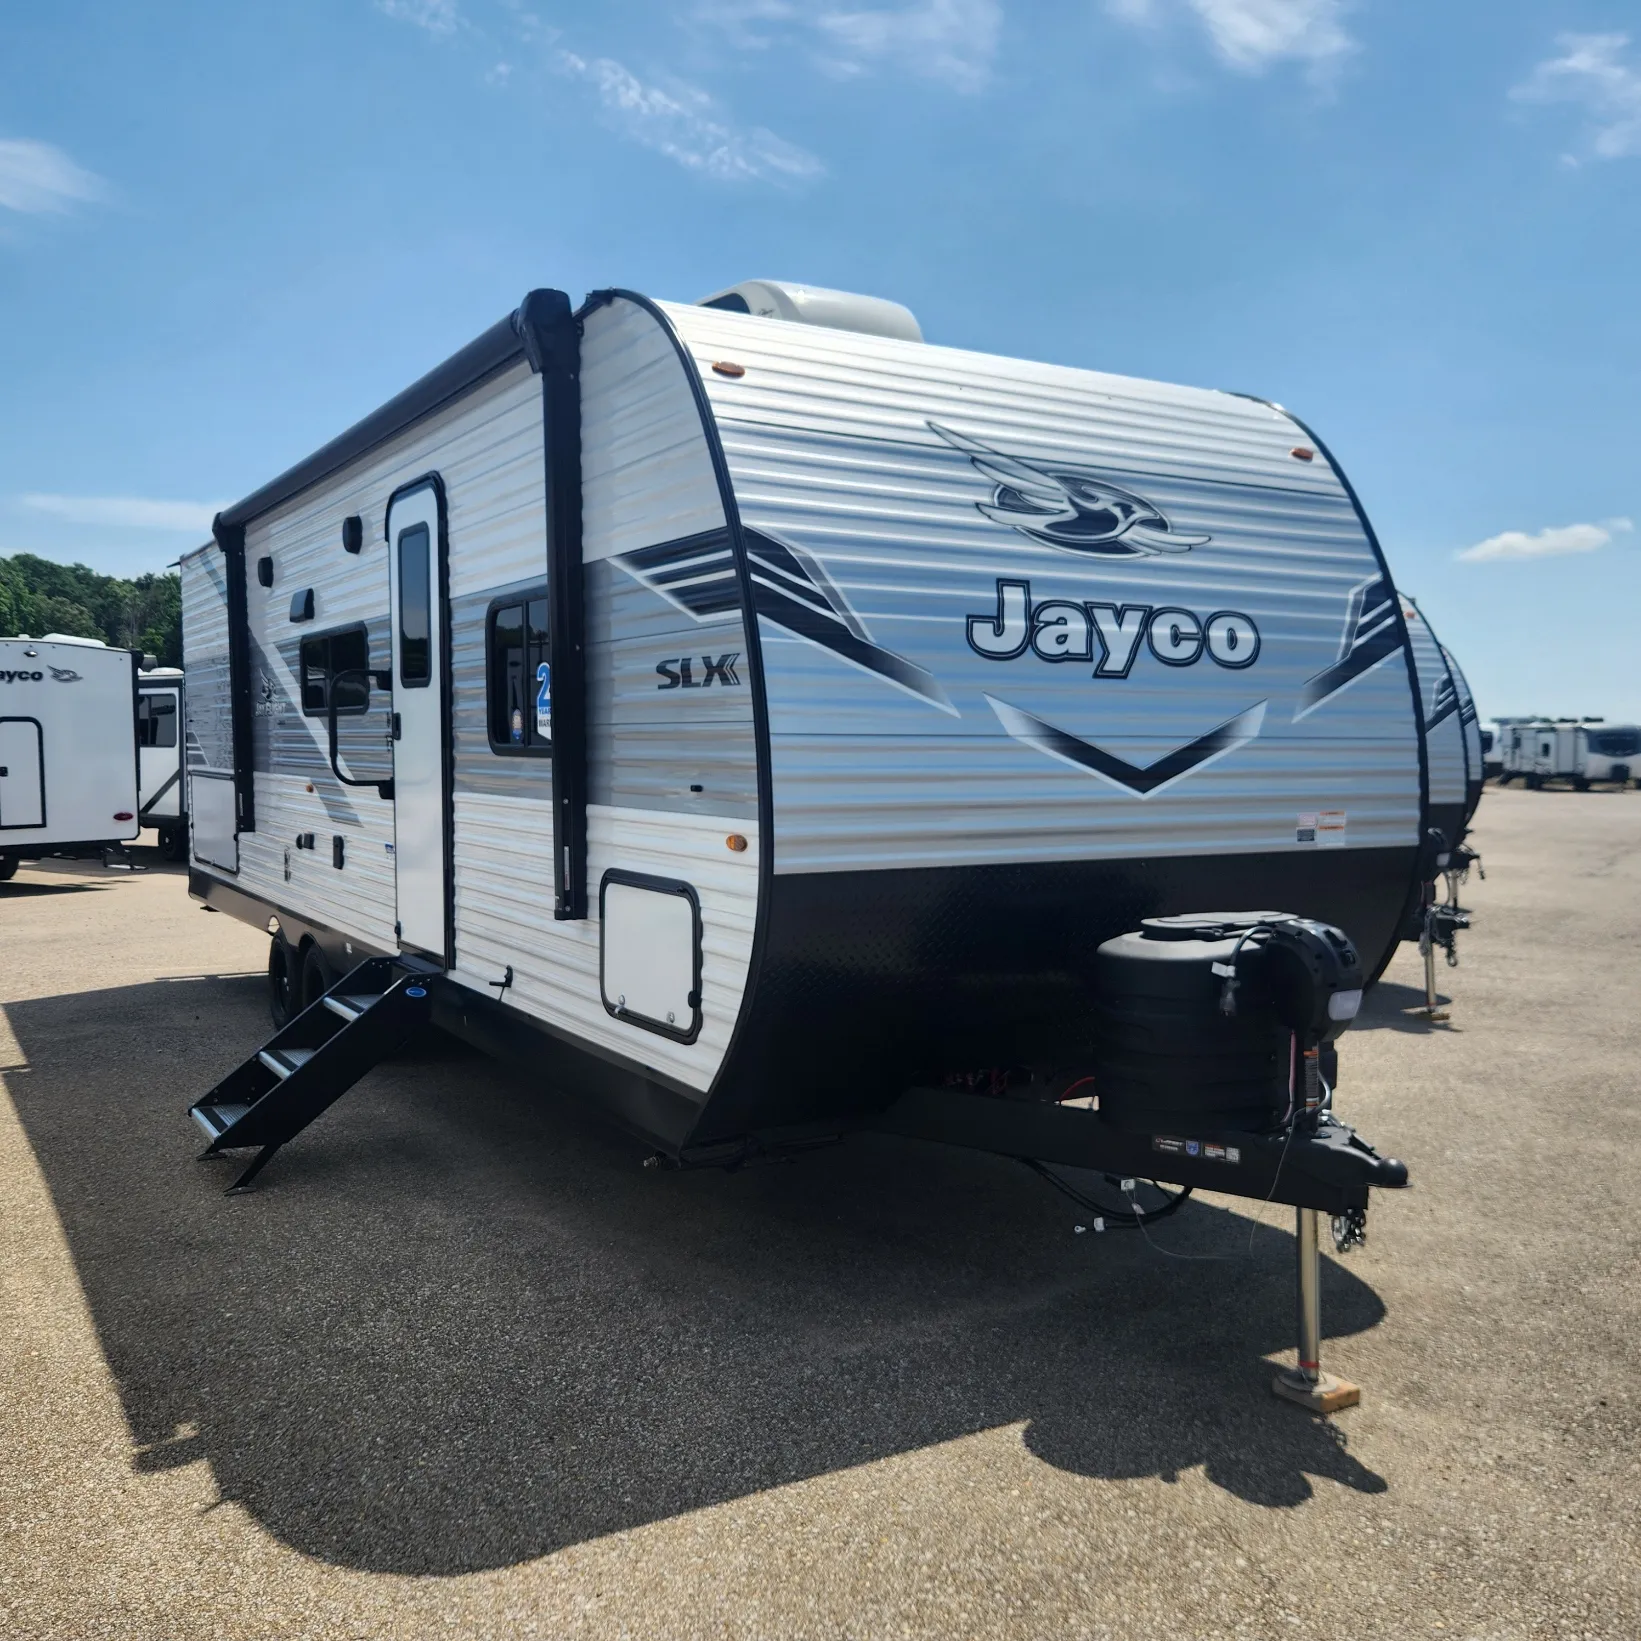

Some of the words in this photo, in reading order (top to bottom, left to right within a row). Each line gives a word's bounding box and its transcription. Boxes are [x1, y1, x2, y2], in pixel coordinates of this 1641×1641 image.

[966, 578, 1260, 679] Jayco
[537, 662, 551, 708] 2
[656, 653, 741, 690] SLX
